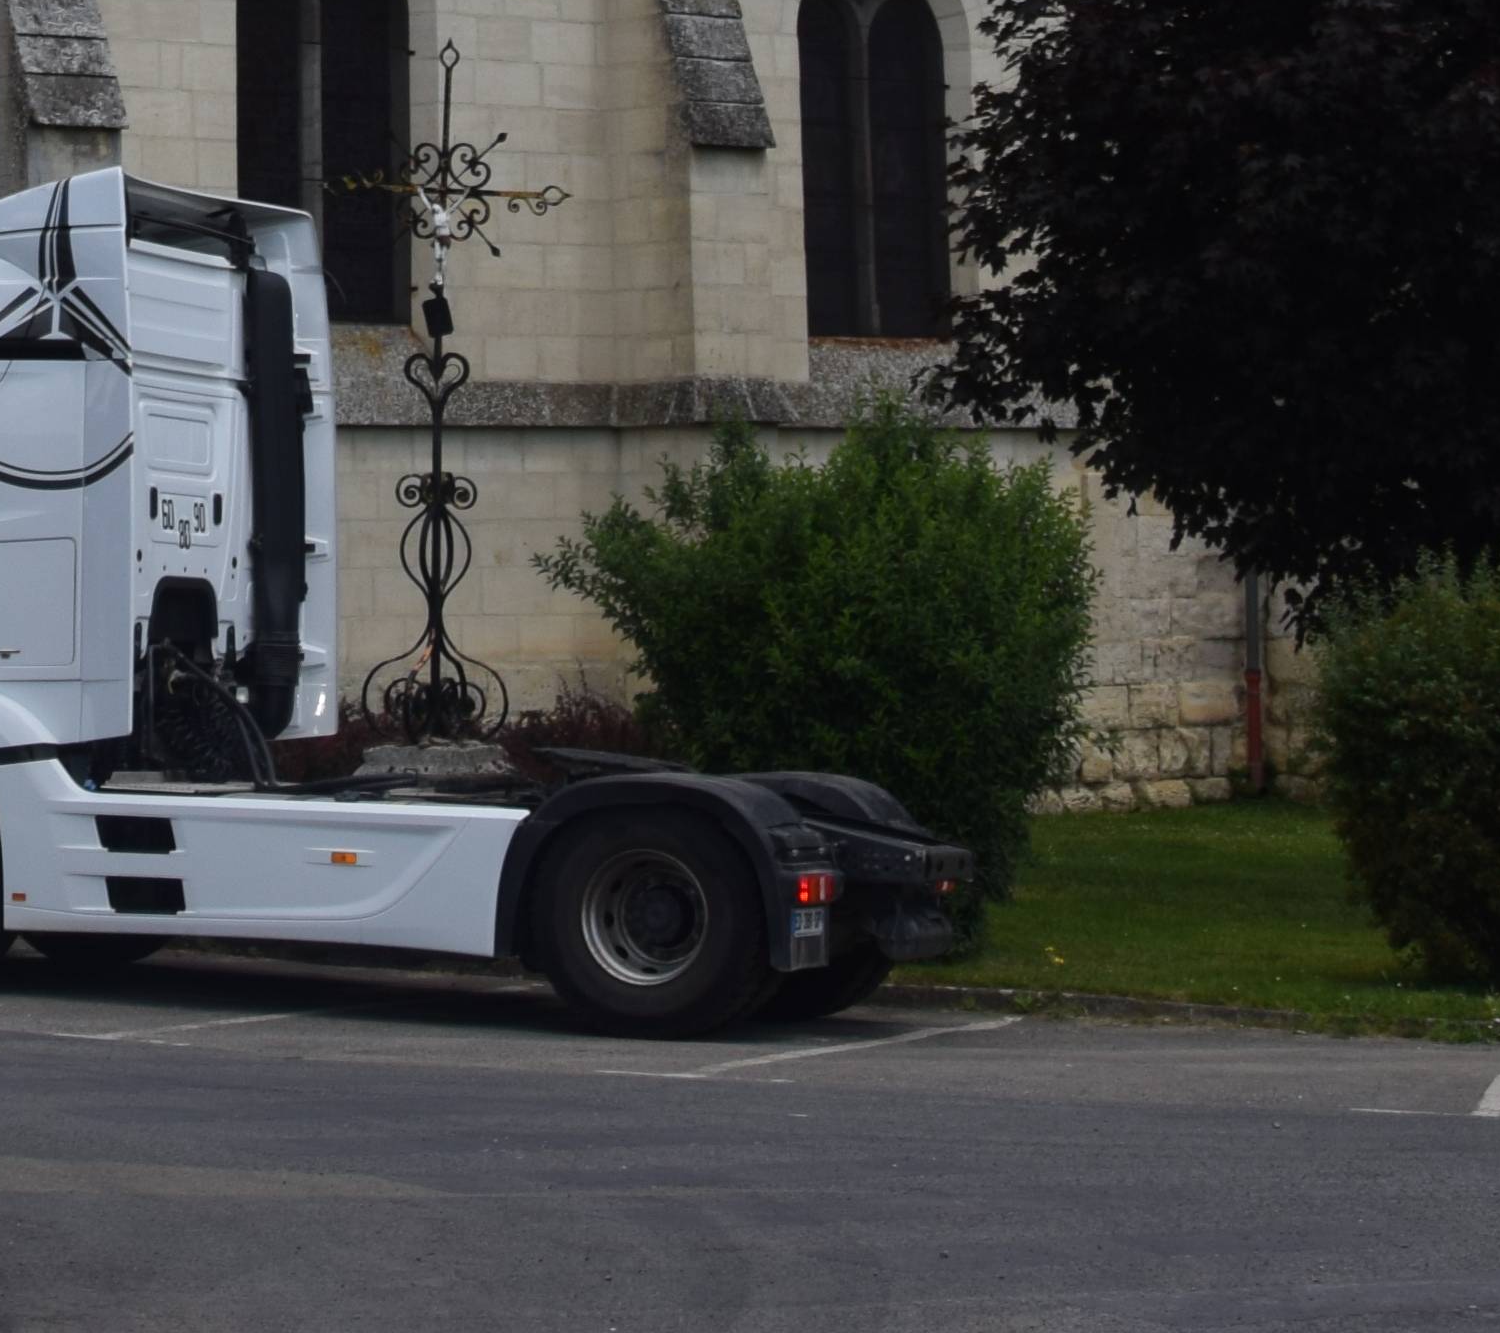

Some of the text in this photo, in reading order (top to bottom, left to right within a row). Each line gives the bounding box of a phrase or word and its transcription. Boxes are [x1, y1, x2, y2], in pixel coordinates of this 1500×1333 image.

[162, 499, 174, 530] 60
[194, 502, 206, 533] 90
[178, 519, 191, 549] 80
